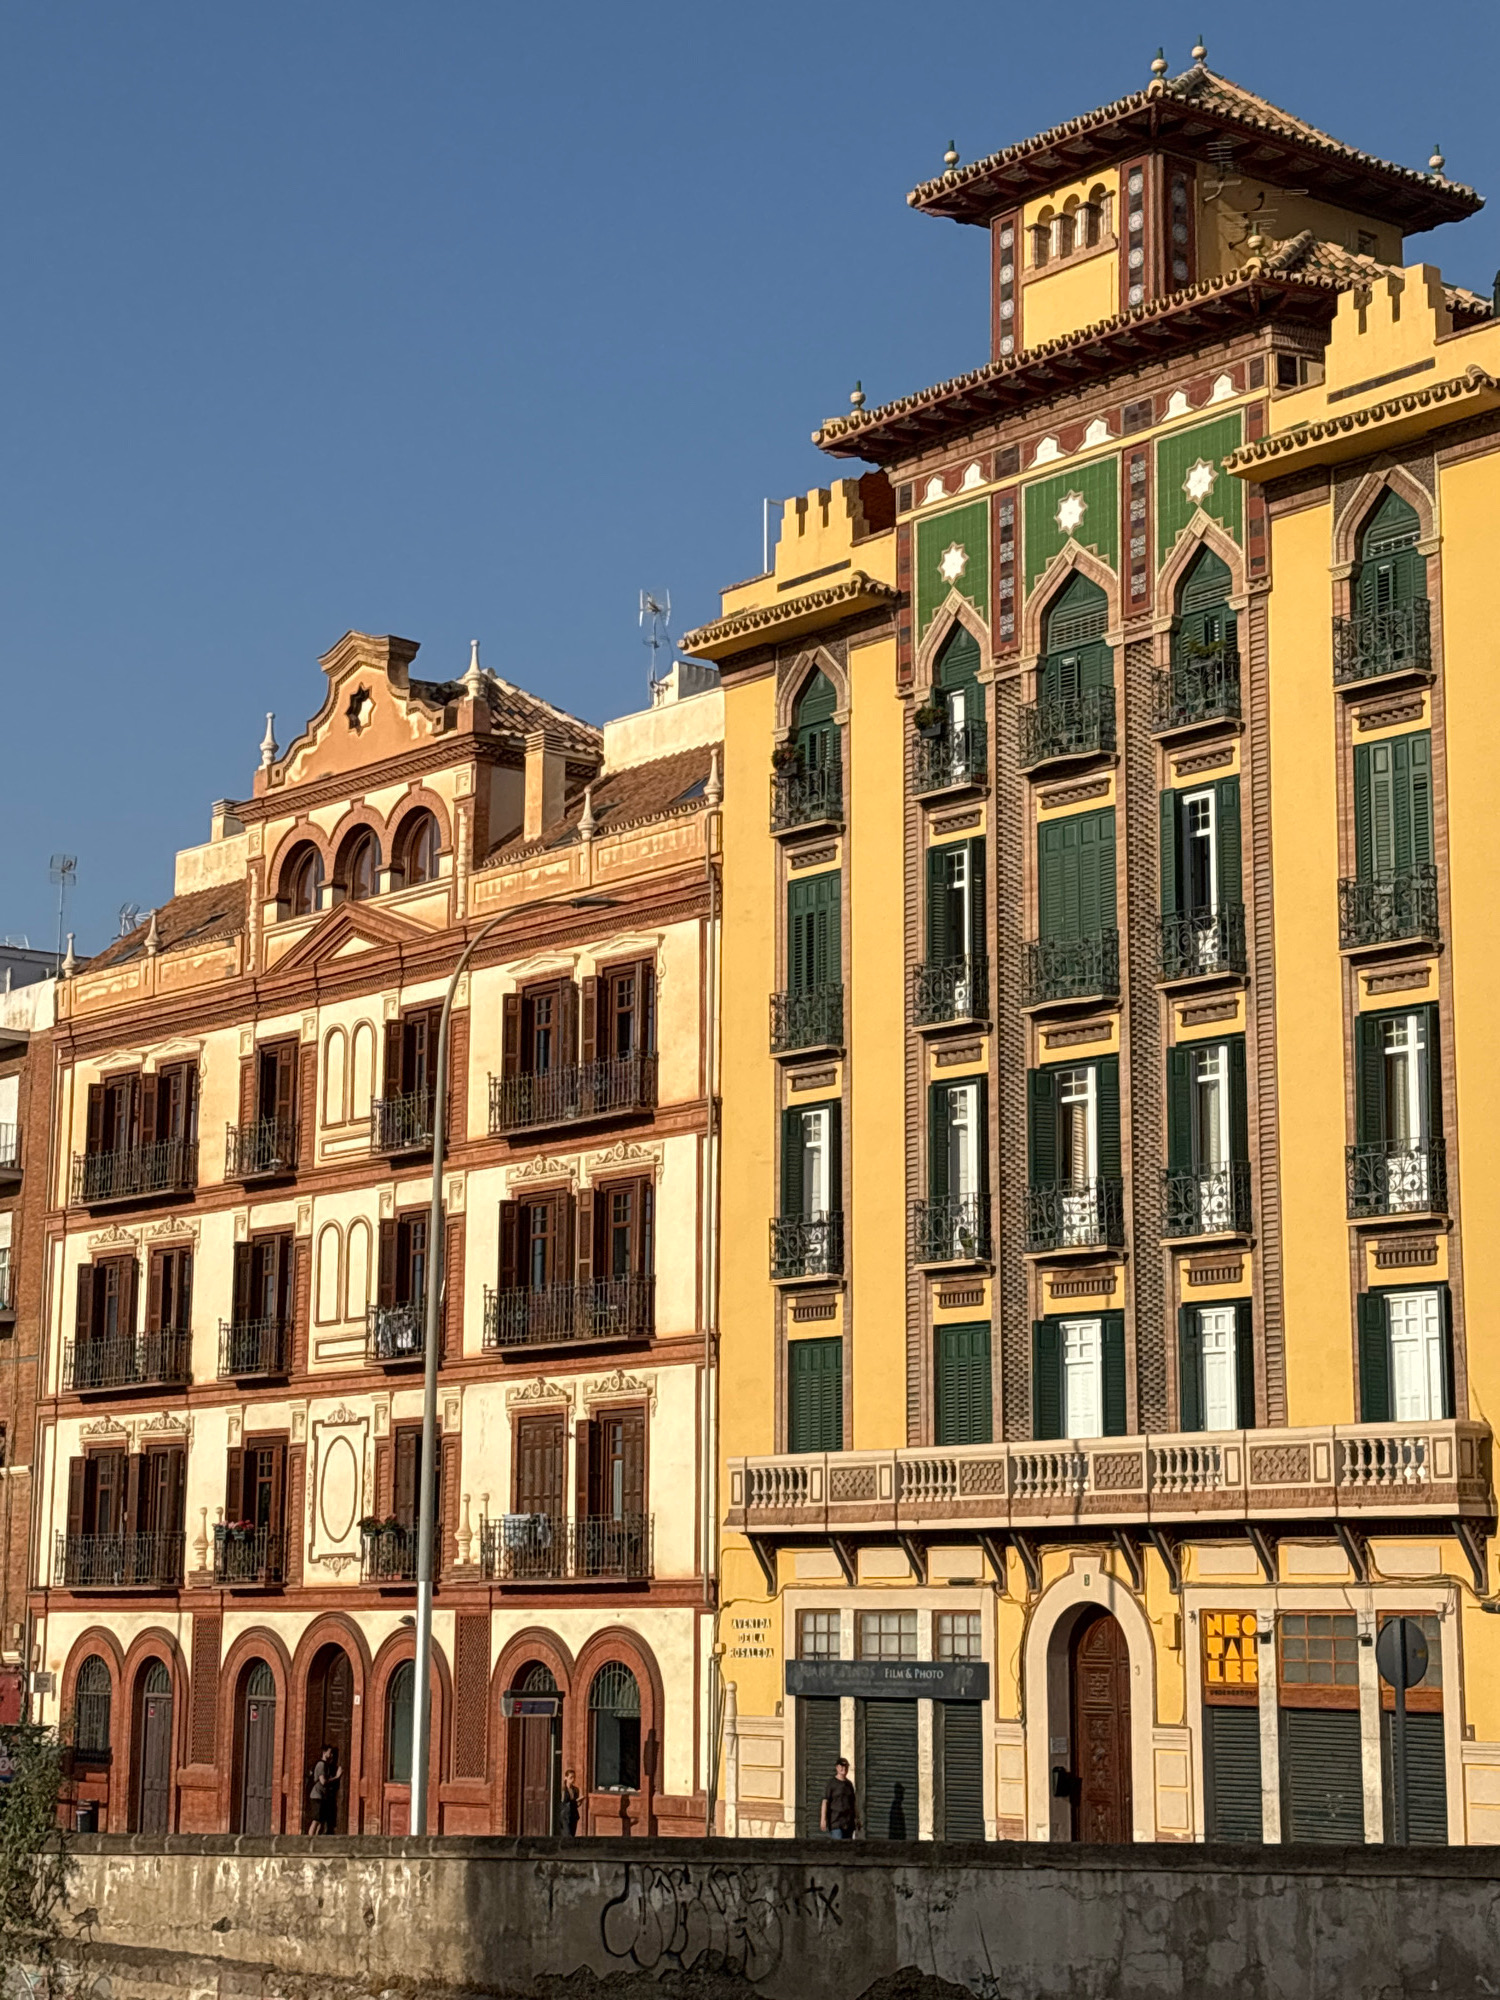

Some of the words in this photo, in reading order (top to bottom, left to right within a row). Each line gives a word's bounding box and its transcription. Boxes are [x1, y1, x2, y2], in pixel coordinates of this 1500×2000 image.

[730, 1617, 772, 1630] AVENIDA
[1207, 1614, 1257, 1636] NEO
[738, 1632, 751, 1643] DE
[752, 1632, 765, 1643] LA
[729, 1647, 775, 1659] ROSALEDA
[1207, 1637, 1258, 1659] TAL
[884, 1667, 904, 1679] FILM
[905, 1667, 913, 1679] &
[914, 1668, 944, 1679] PHOTO
[1208, 1660, 1258, 1683] LER
